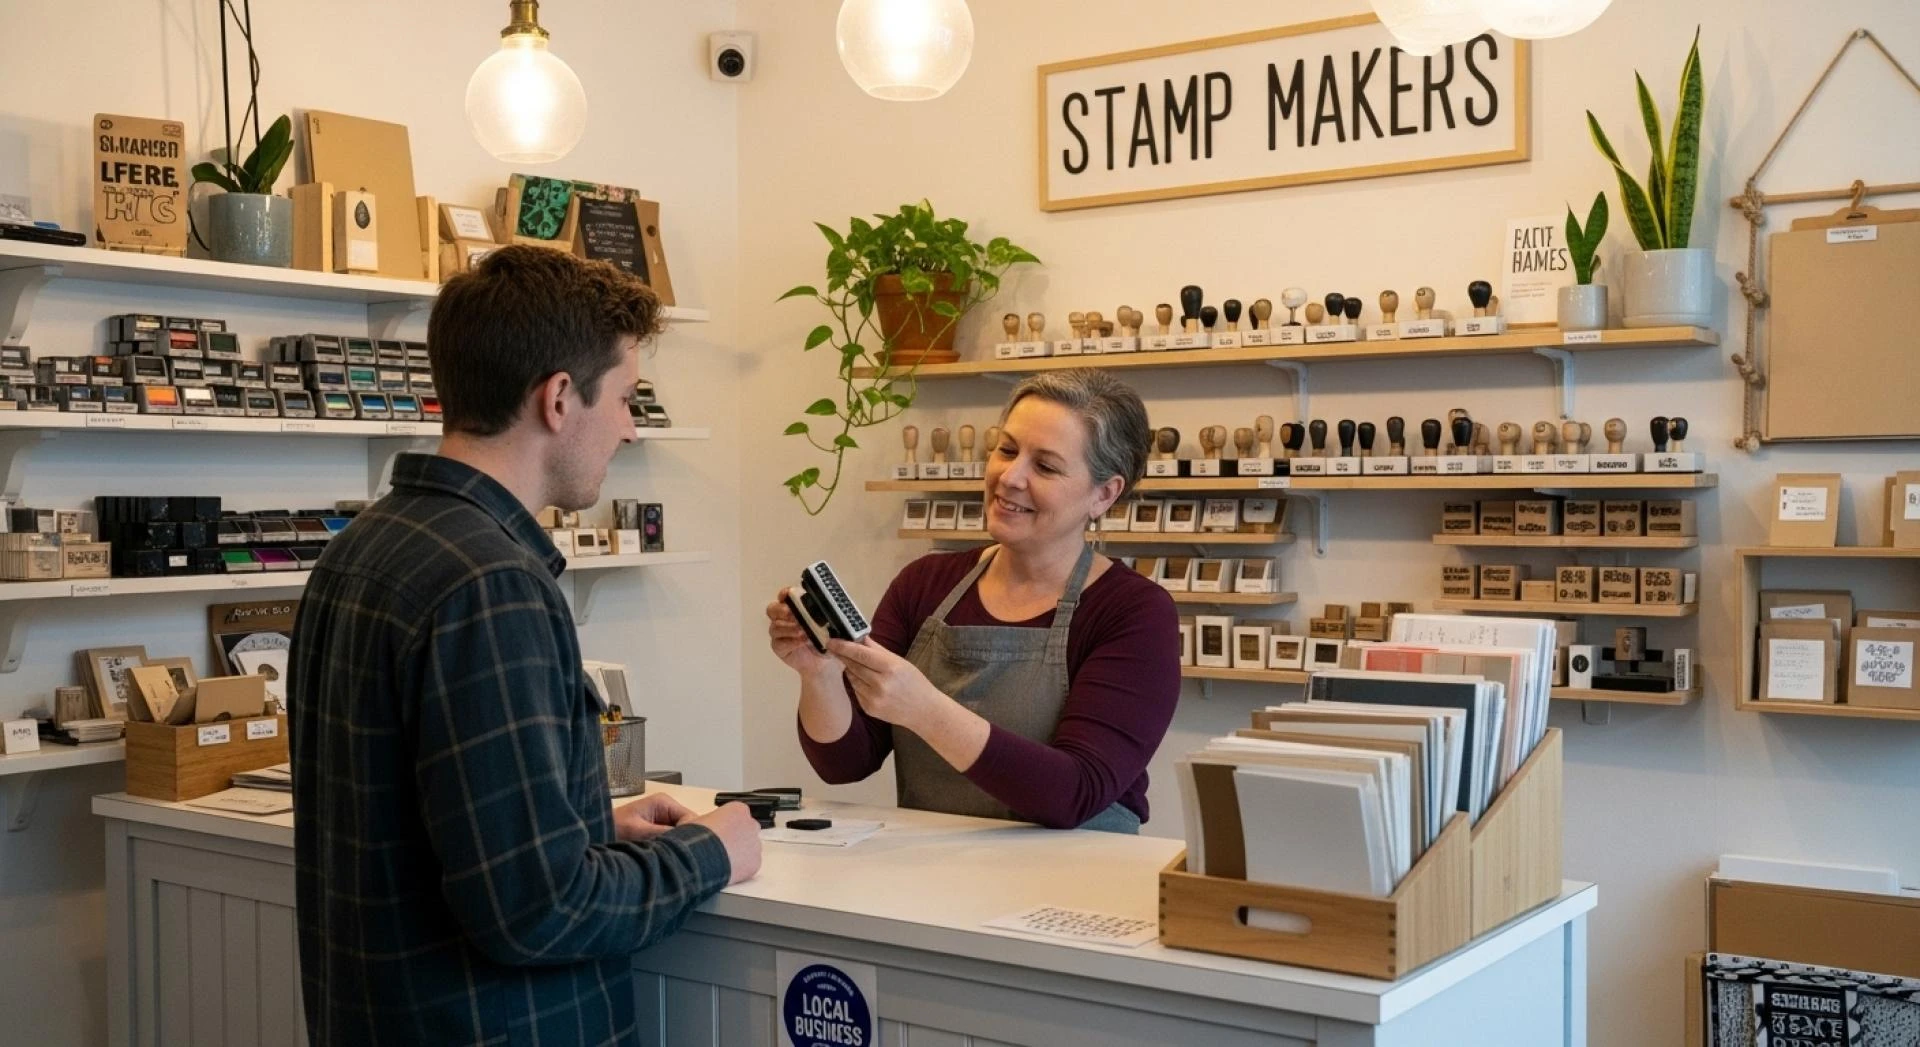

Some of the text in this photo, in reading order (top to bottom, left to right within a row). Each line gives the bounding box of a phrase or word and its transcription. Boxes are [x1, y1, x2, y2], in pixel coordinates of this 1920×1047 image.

[1062, 33, 1499, 176] STAMP MAKERS
[1512, 248, 1567, 273] HAMES
[803, 993, 854, 1023] LOCAL
[795, 1016, 863, 1046] BUSINESS
